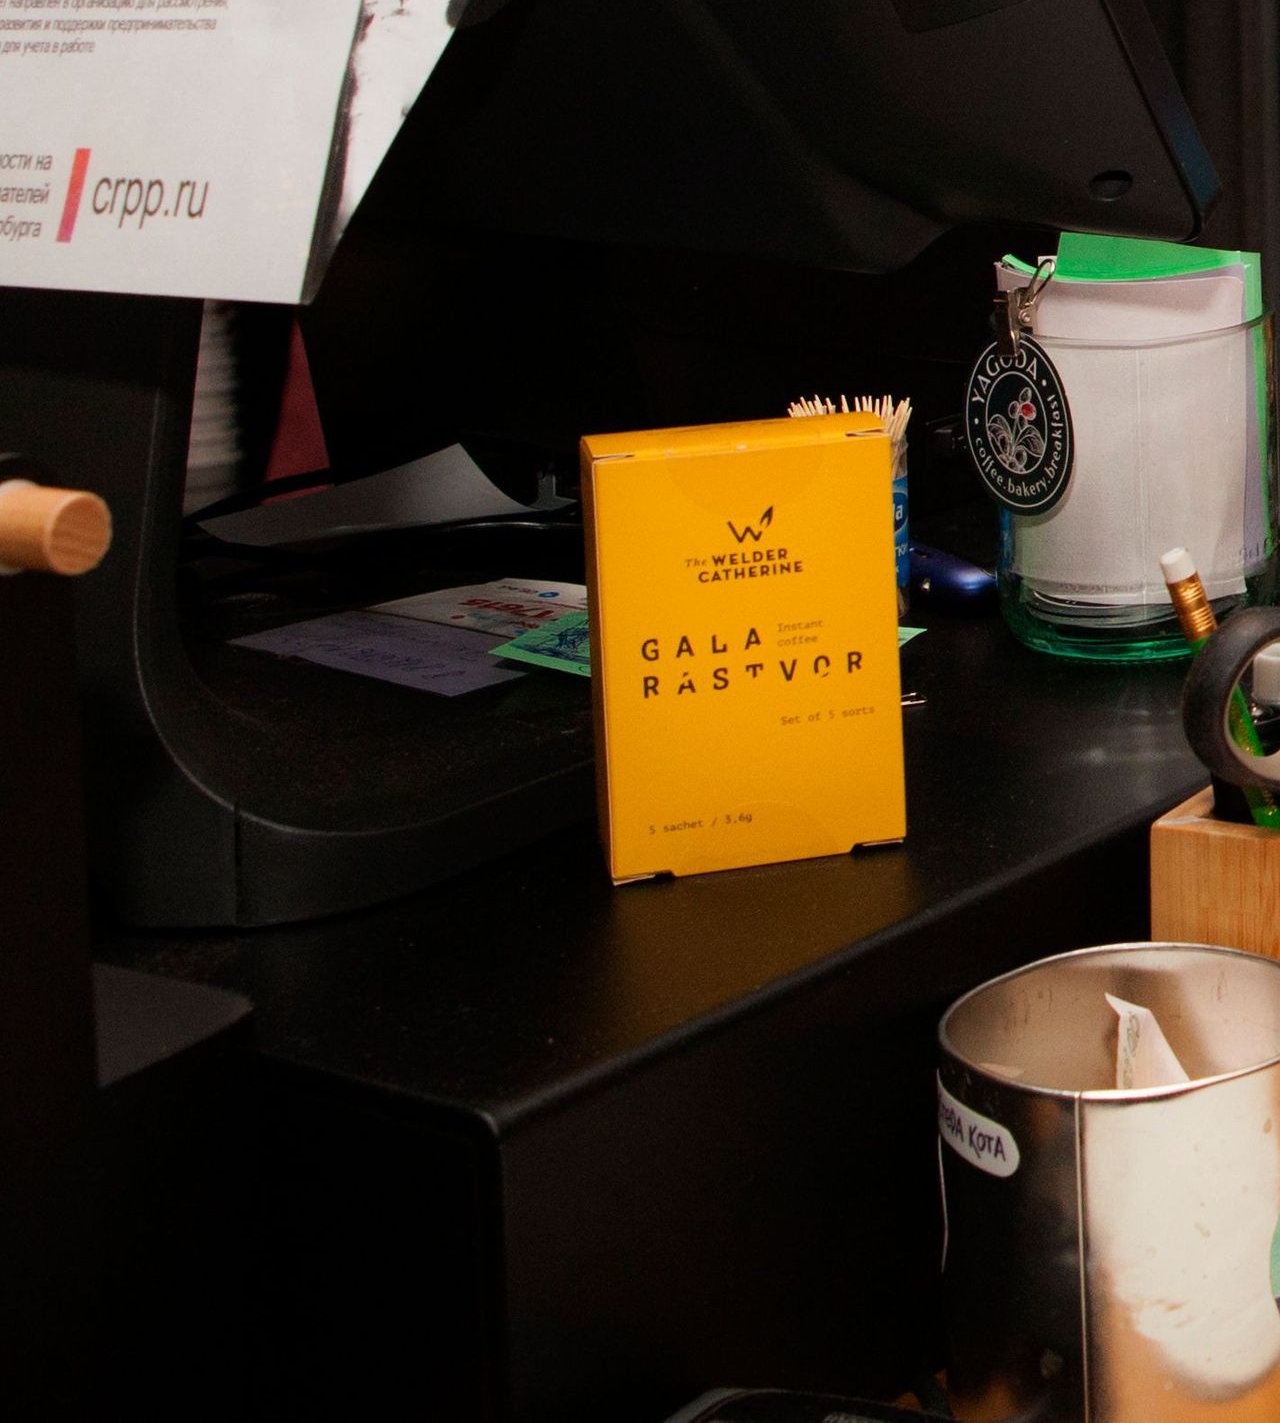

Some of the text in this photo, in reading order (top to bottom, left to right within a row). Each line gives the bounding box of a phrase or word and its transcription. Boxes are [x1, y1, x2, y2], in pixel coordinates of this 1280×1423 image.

[35, 153, 53, 171] на
[91, 177, 210, 230] crpp.ru
[685, 548, 789, 568] The WELDER
[698, 561, 804, 584] CATHERINE
[777, 618, 824, 633] Instant
[640, 627, 763, 662] GALA
[777, 633, 819, 648] coffee
[780, 713, 801, 727] Set
[808, 710, 821, 723] of
[841, 705, 876, 718] sorts
[663, 817, 704, 834] sachet
[969, 1125, 1007, 1163] КОТА
